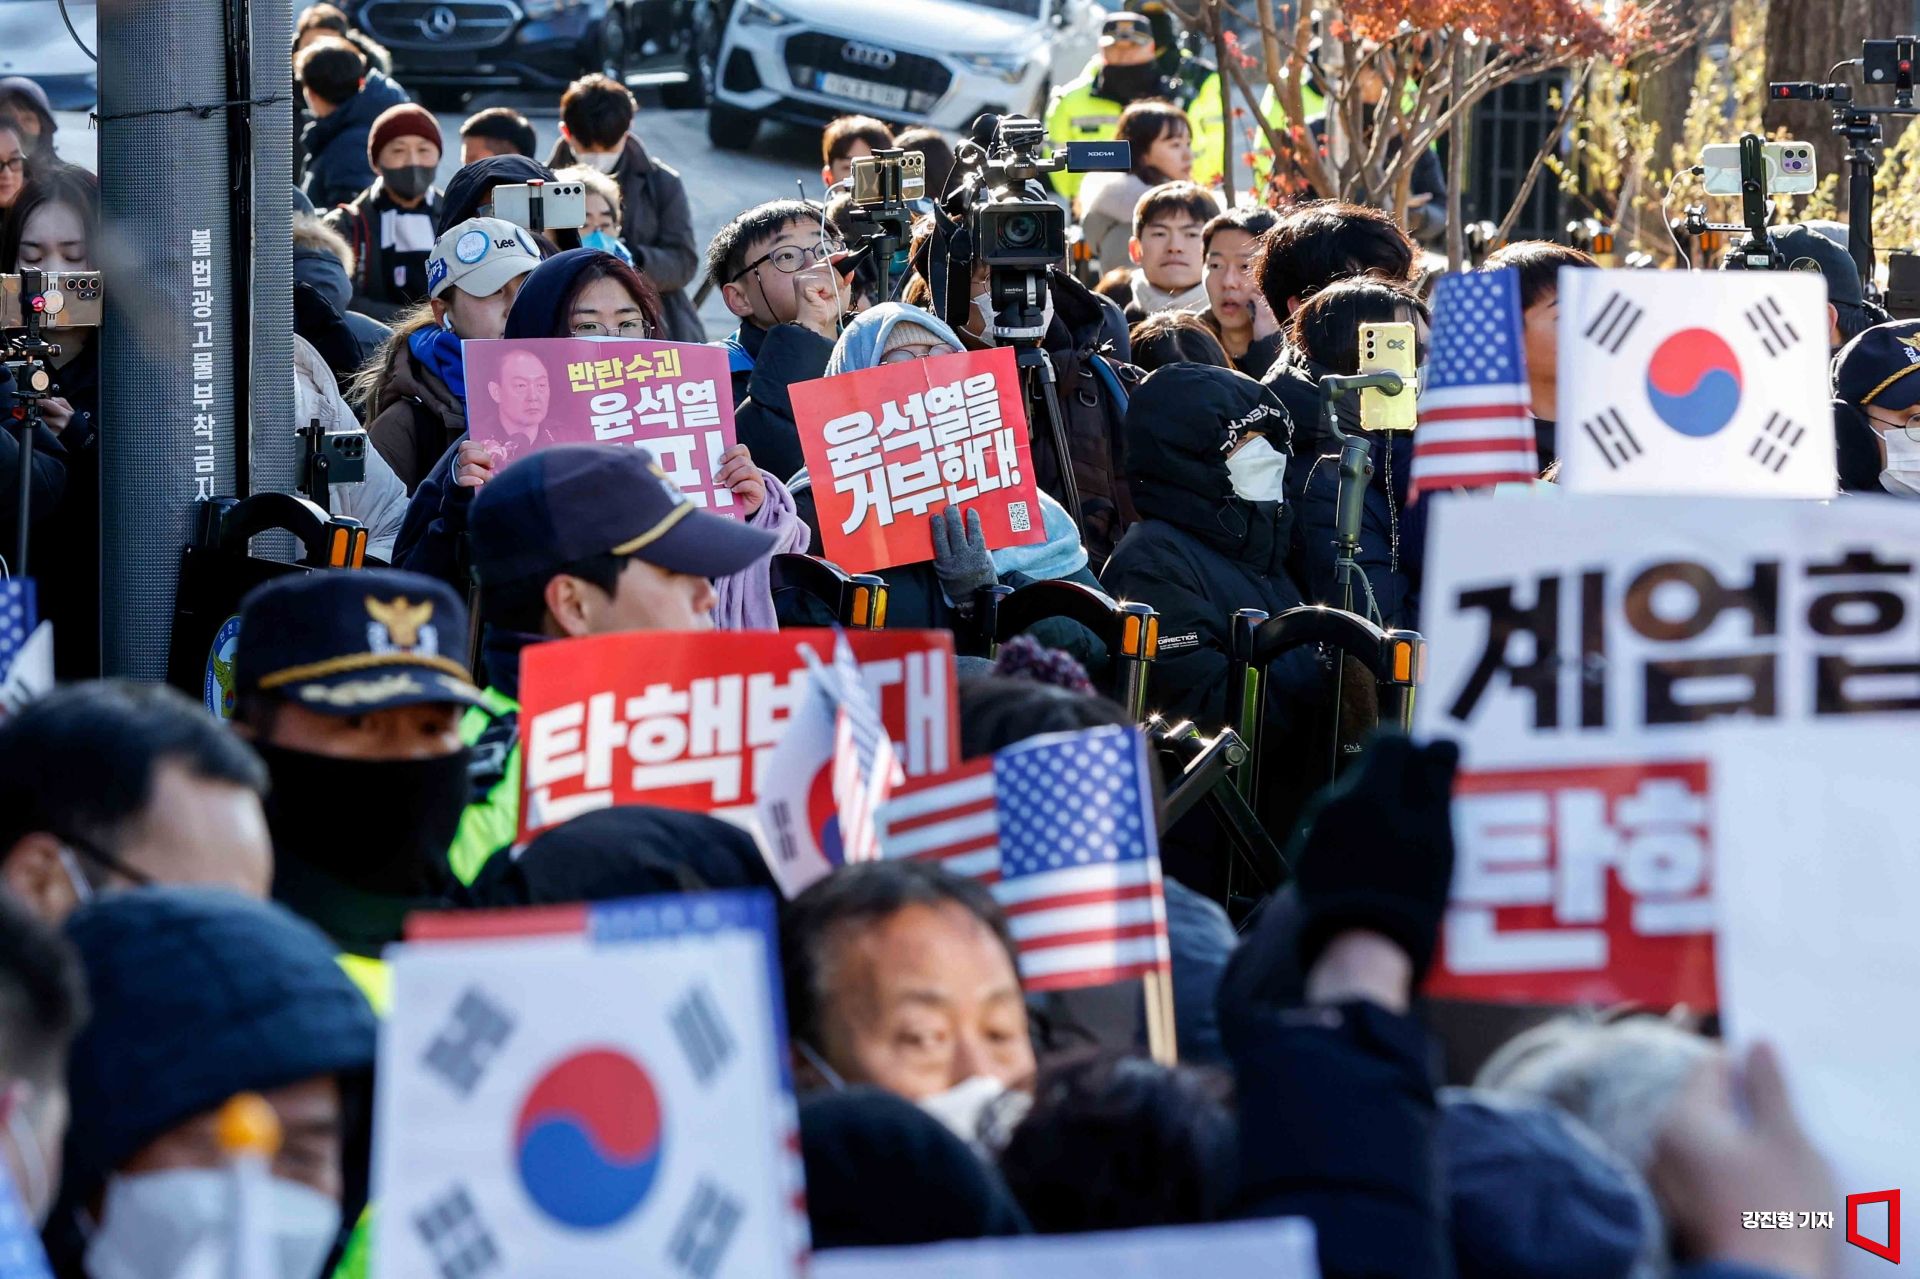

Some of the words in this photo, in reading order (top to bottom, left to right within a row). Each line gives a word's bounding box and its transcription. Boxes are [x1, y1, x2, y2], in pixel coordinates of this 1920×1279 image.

[494, 239, 516, 249] Lee
[567, 348, 682, 393] 반란수괴
[590, 379, 721, 441] 윤석열
[823, 372, 1003, 479] 윤석열을
[610, 430, 734, 508] 포!
[1157, 634, 1198, 645] DIRECTION
